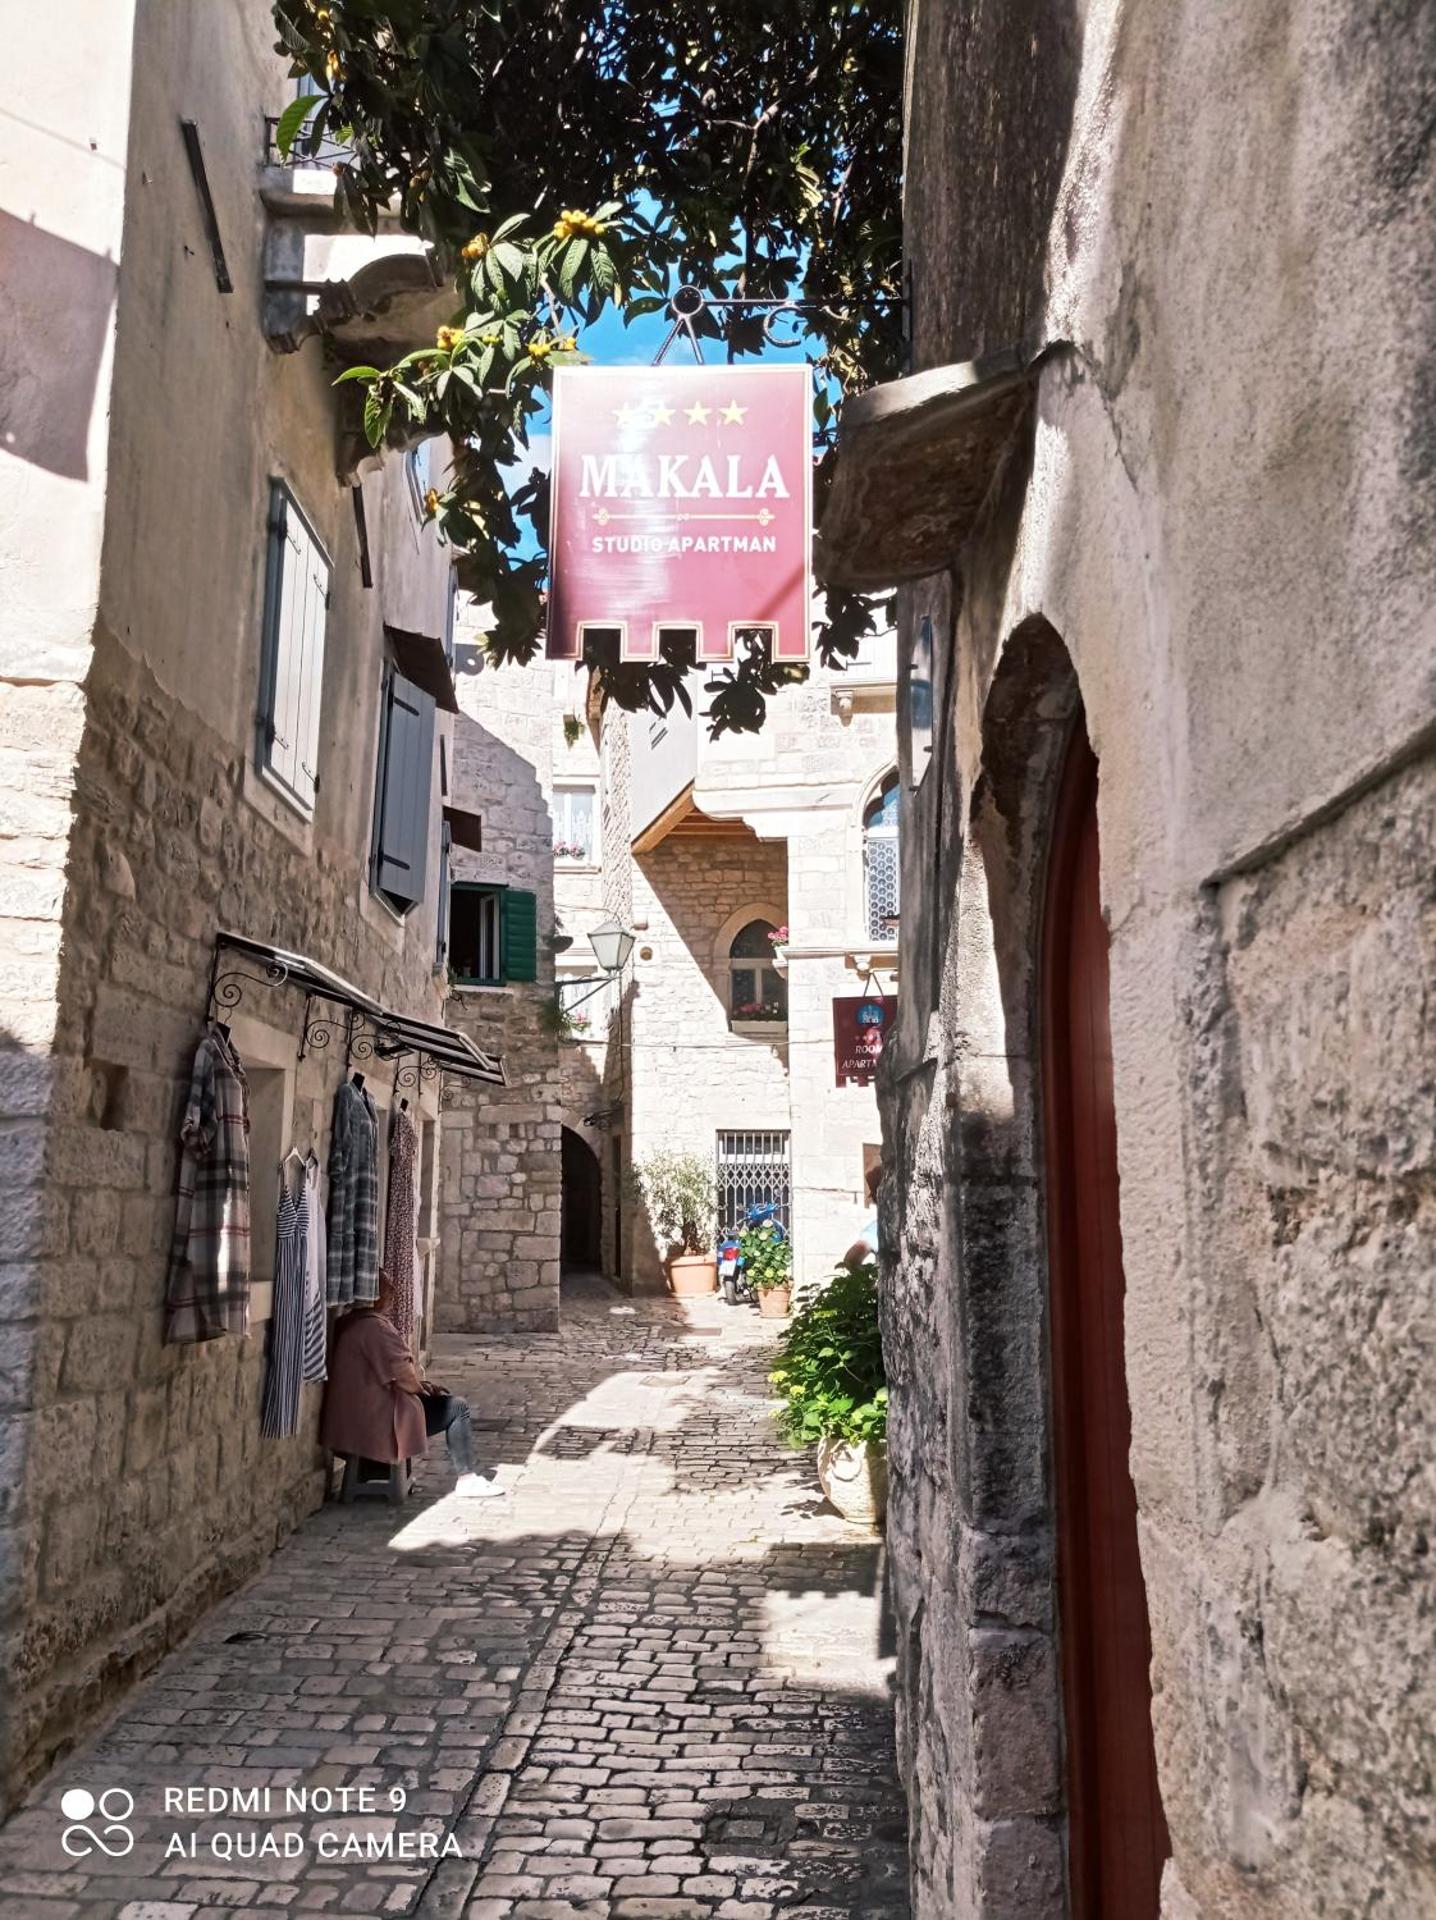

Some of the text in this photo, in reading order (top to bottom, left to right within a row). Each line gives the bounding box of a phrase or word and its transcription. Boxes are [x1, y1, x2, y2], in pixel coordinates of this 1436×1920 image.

[579, 454, 790, 498] MAKALA
[592, 536, 776, 553] STUDIO APARTMAN
